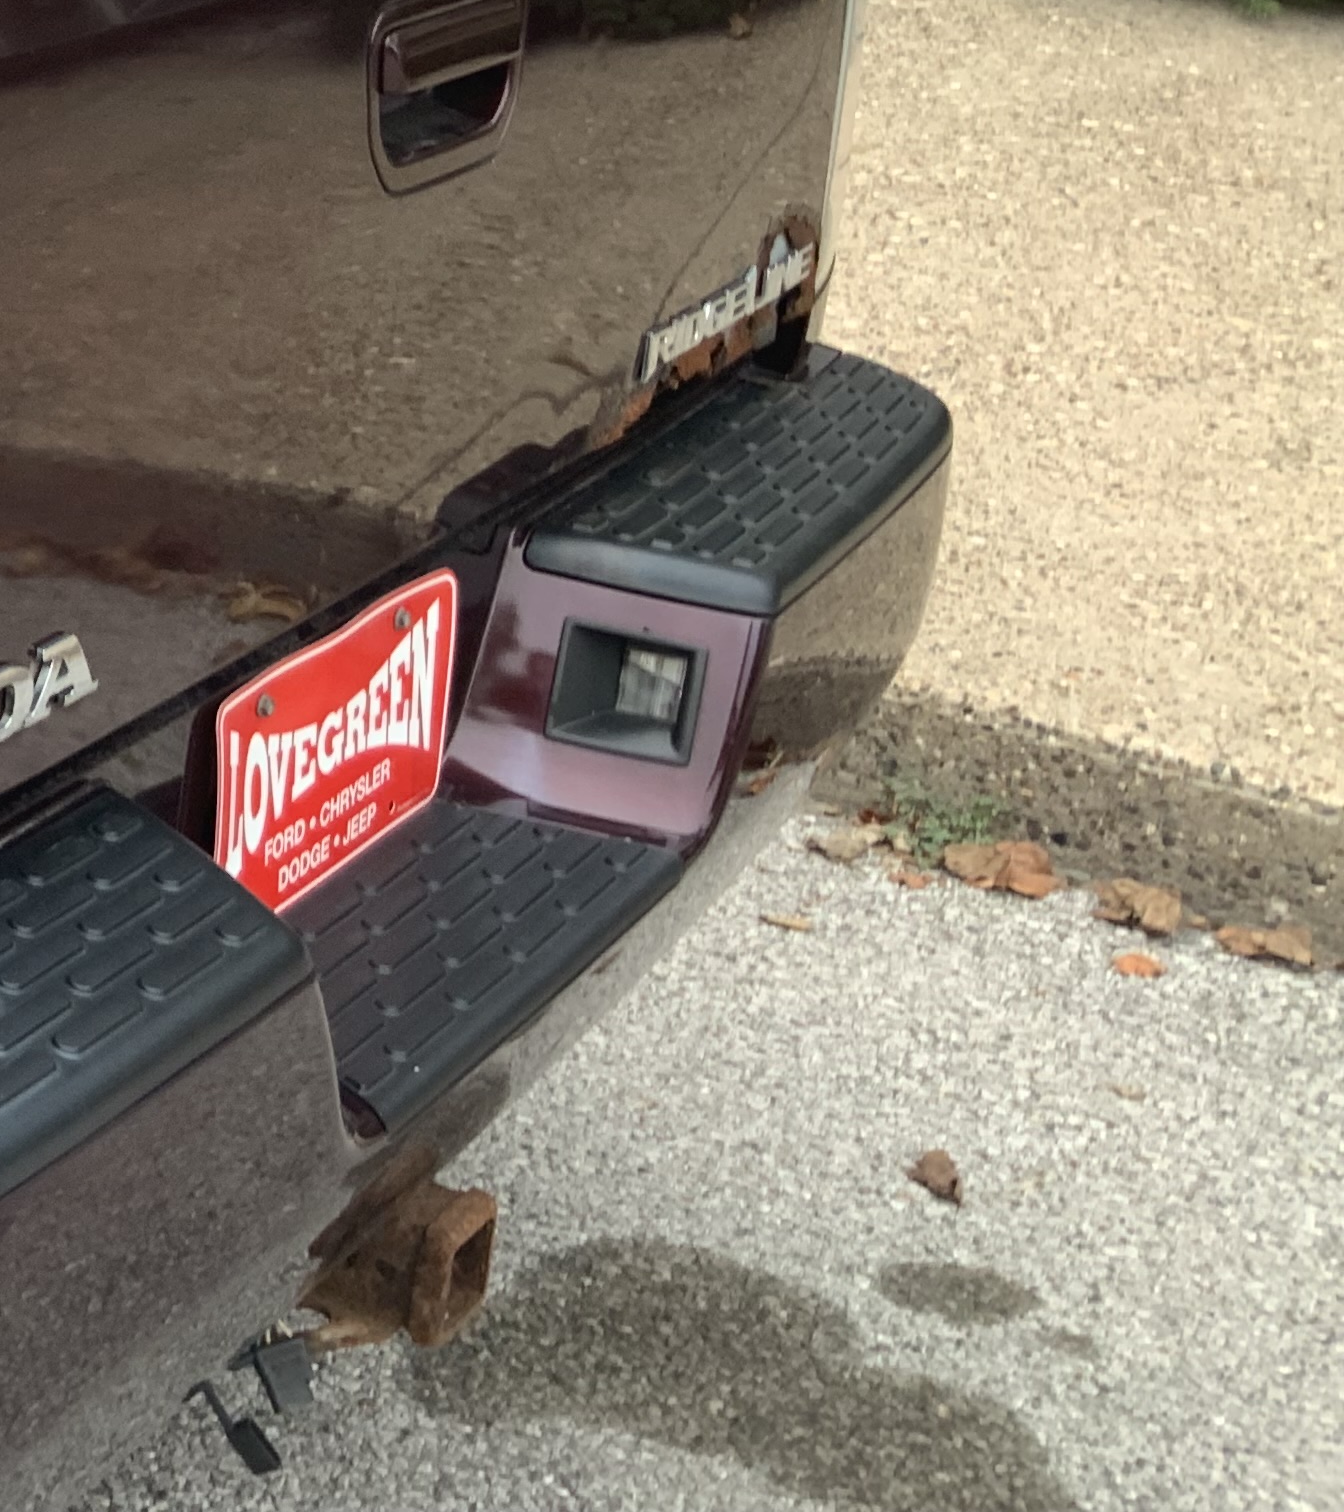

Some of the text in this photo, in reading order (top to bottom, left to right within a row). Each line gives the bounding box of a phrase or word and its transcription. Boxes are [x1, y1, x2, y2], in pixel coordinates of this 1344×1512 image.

[225, 597, 441, 879] LOVEGREEN
[263, 817, 306, 867] FORD
[319, 757, 392, 828] CHRYSLER
[277, 801, 378, 893] DODGE JEEP
